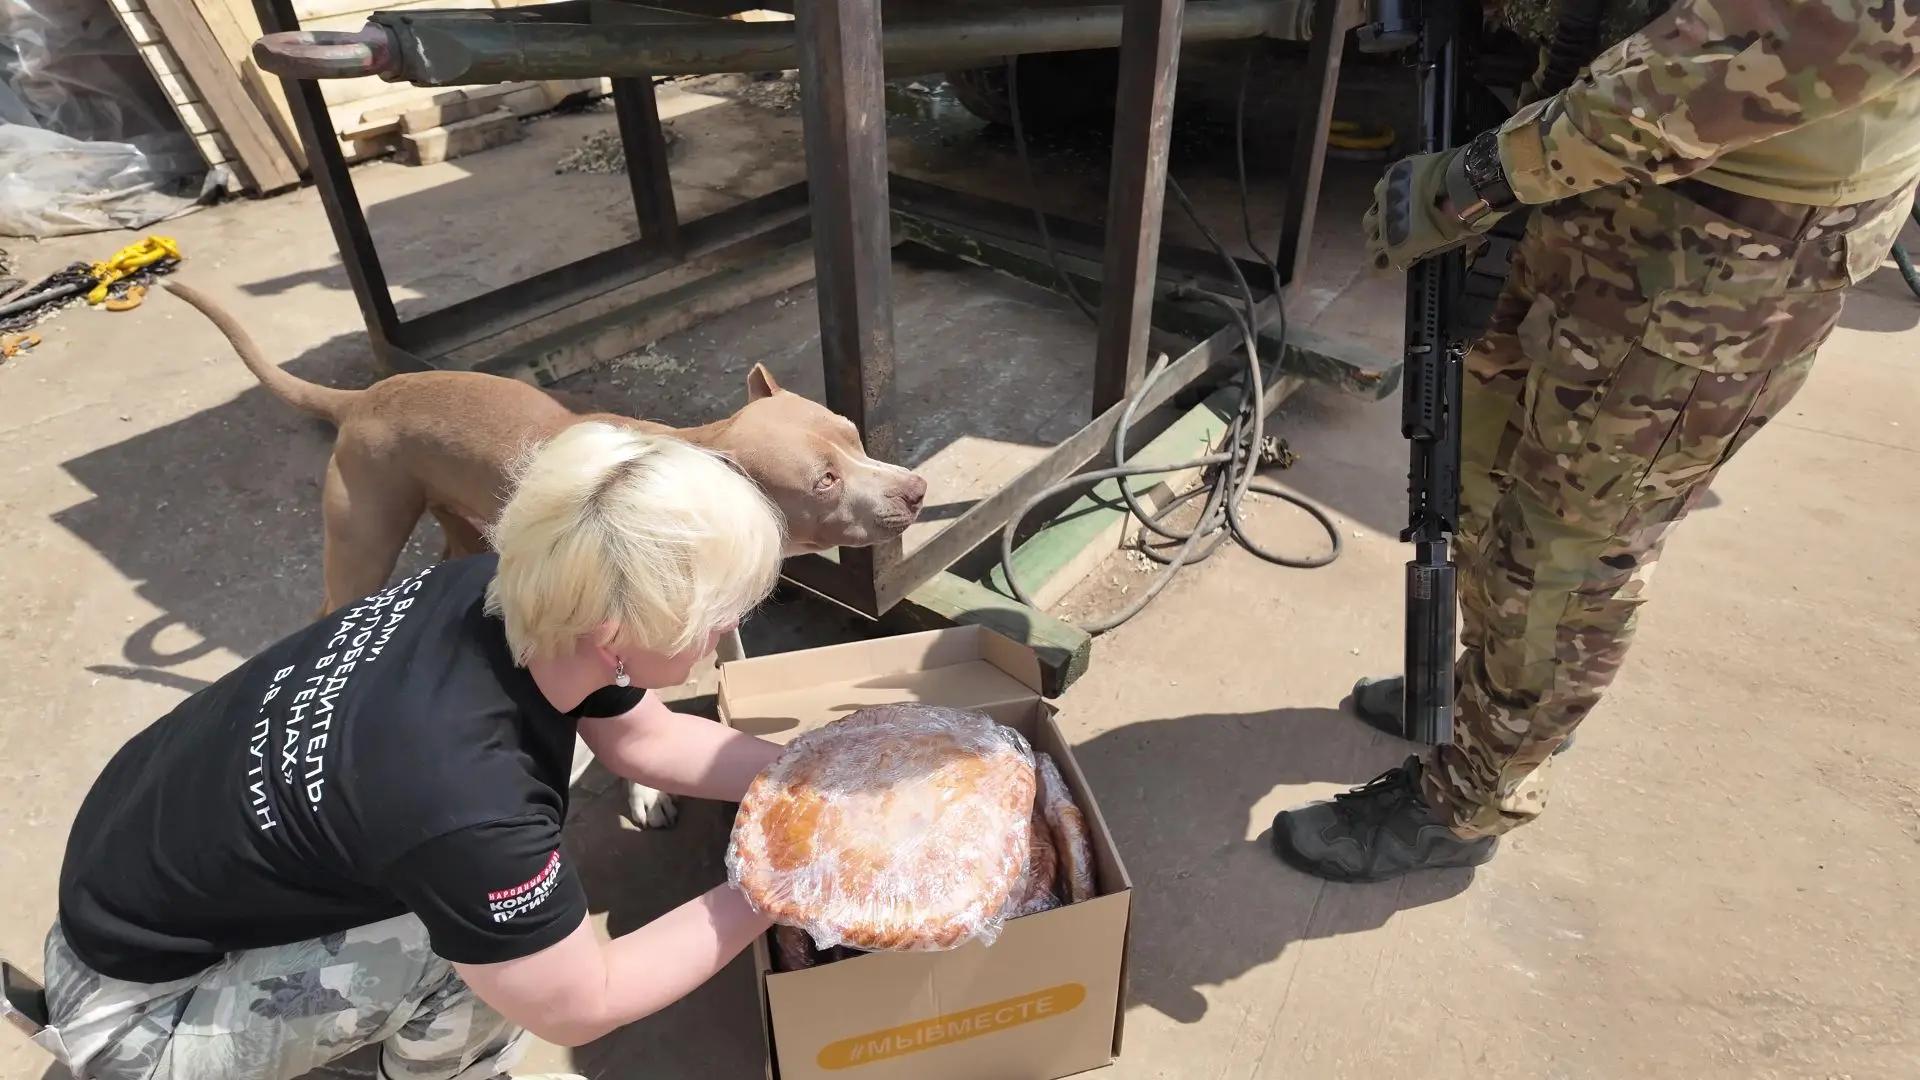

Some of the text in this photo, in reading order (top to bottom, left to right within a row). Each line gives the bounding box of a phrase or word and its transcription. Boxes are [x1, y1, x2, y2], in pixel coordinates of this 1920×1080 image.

[327, 605, 370, 650] НАС
[315, 652, 338, 670] В
[281, 674, 326, 785] ГЕНАХ»
[248, 717, 277, 831] ПУТИН
[493, 883, 558, 923] ПУТИН
